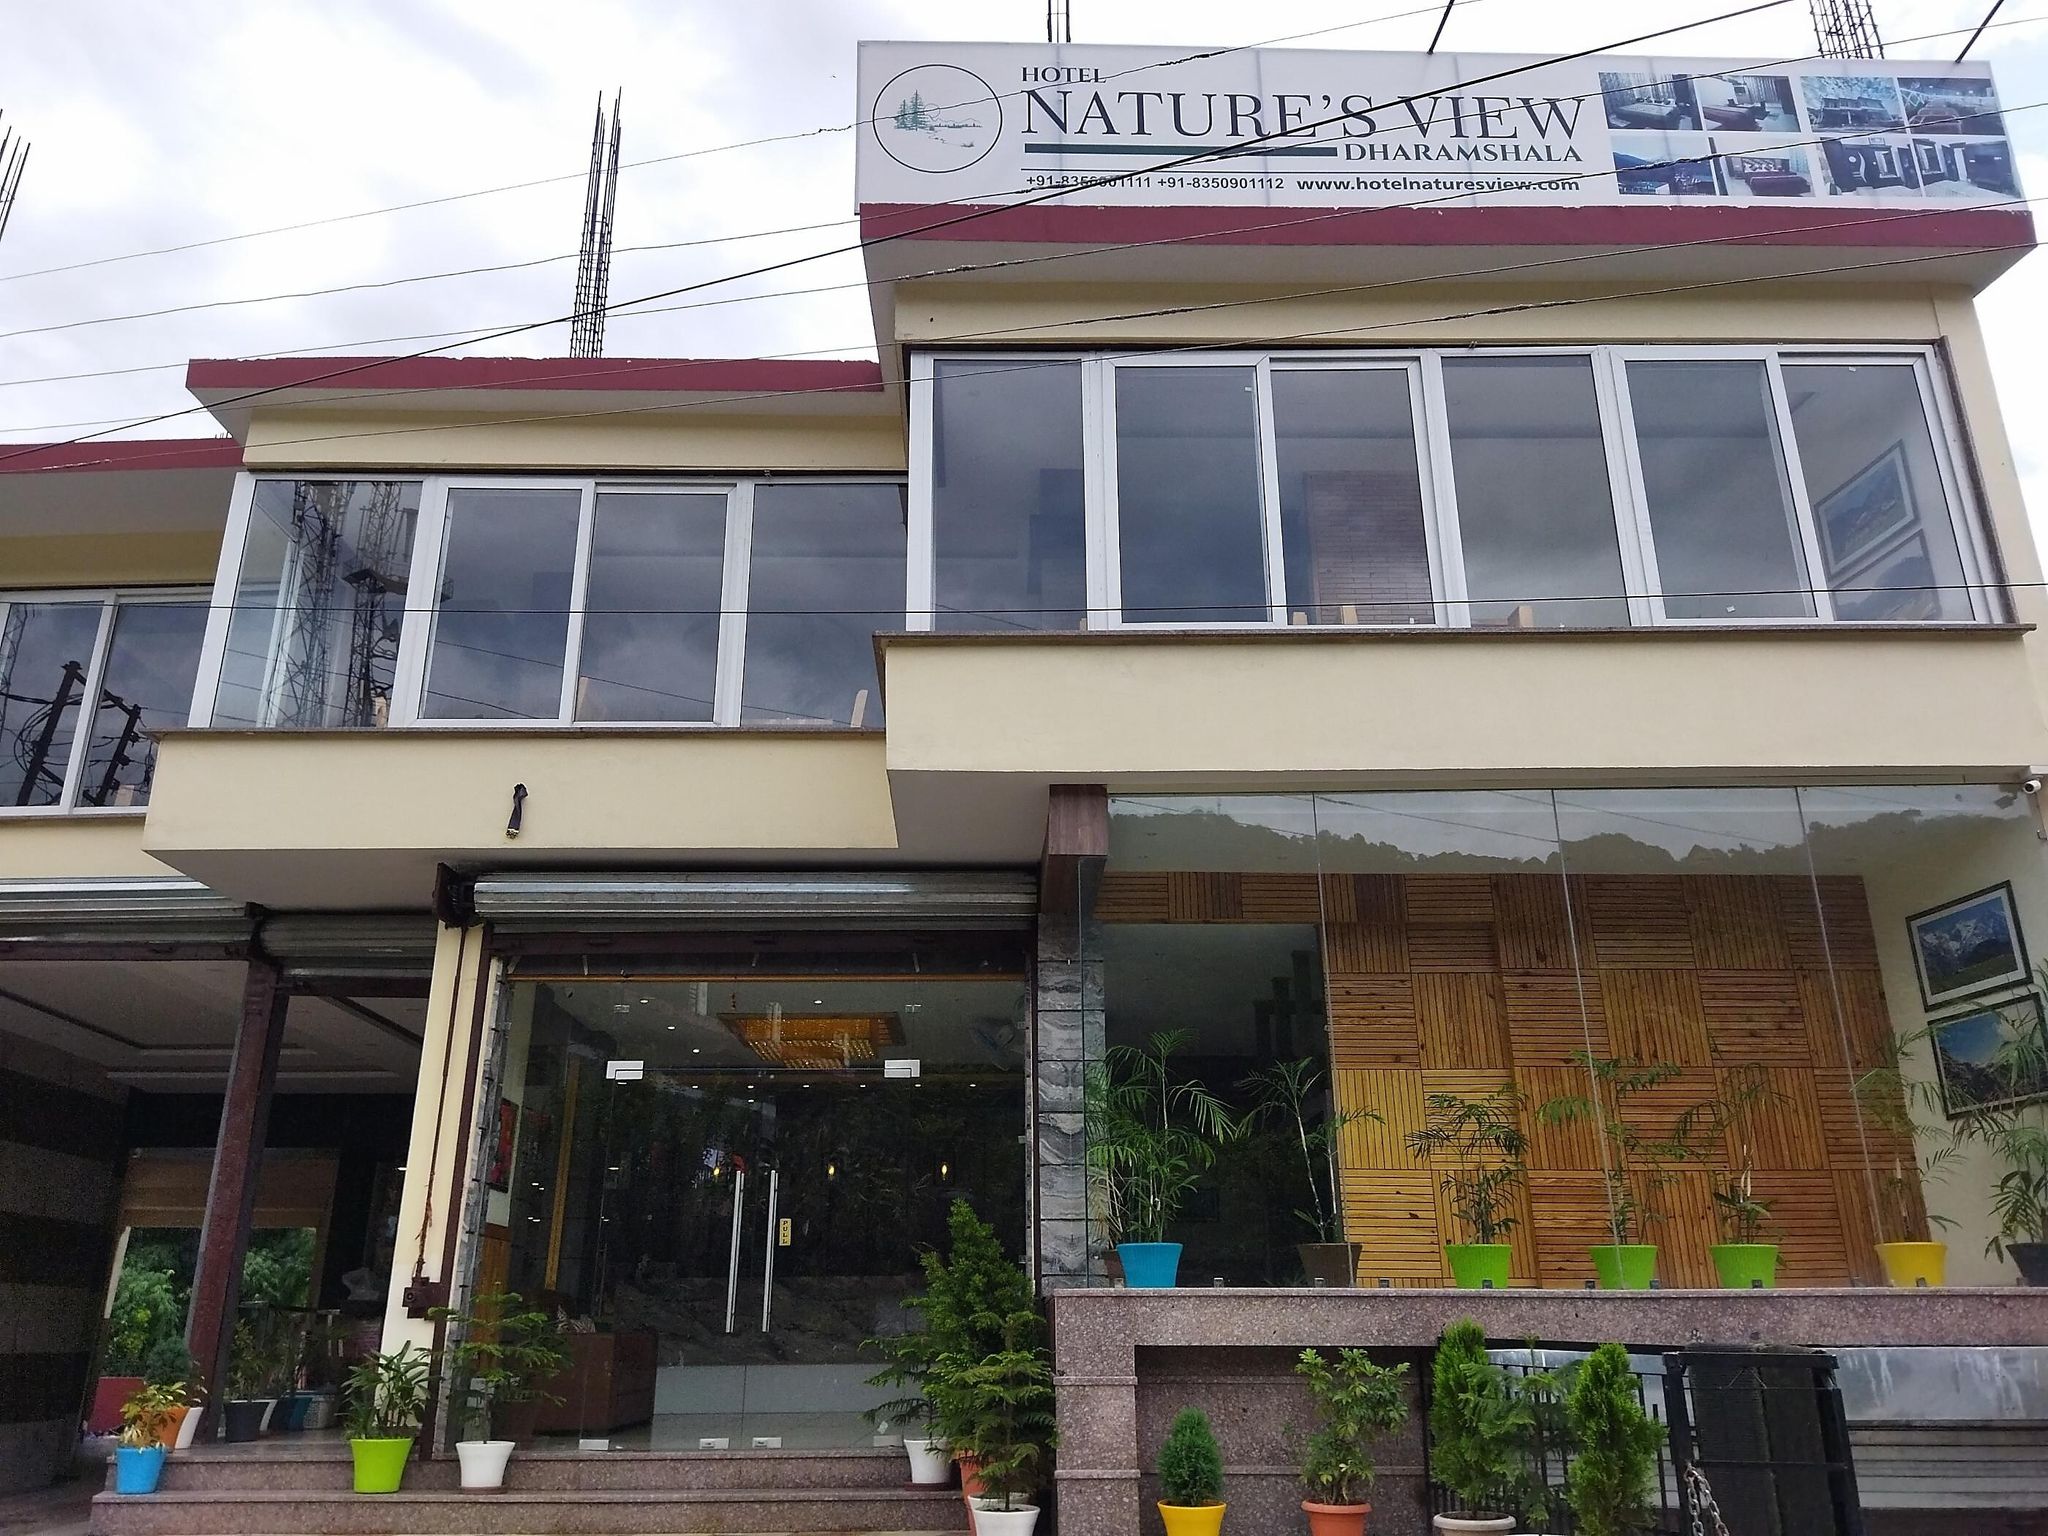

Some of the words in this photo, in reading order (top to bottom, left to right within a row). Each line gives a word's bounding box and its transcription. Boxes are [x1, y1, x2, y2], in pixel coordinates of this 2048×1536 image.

[1021, 66, 1107, 84] HOTEL
[1397, 95, 1586, 140] VIEW
[1345, 142, 1584, 163] DHARAMSHALA
[1157, 176, 1285, 190] +91-8350901112
[1296, 176, 1581, 192] www.hotelnaturesview.com
